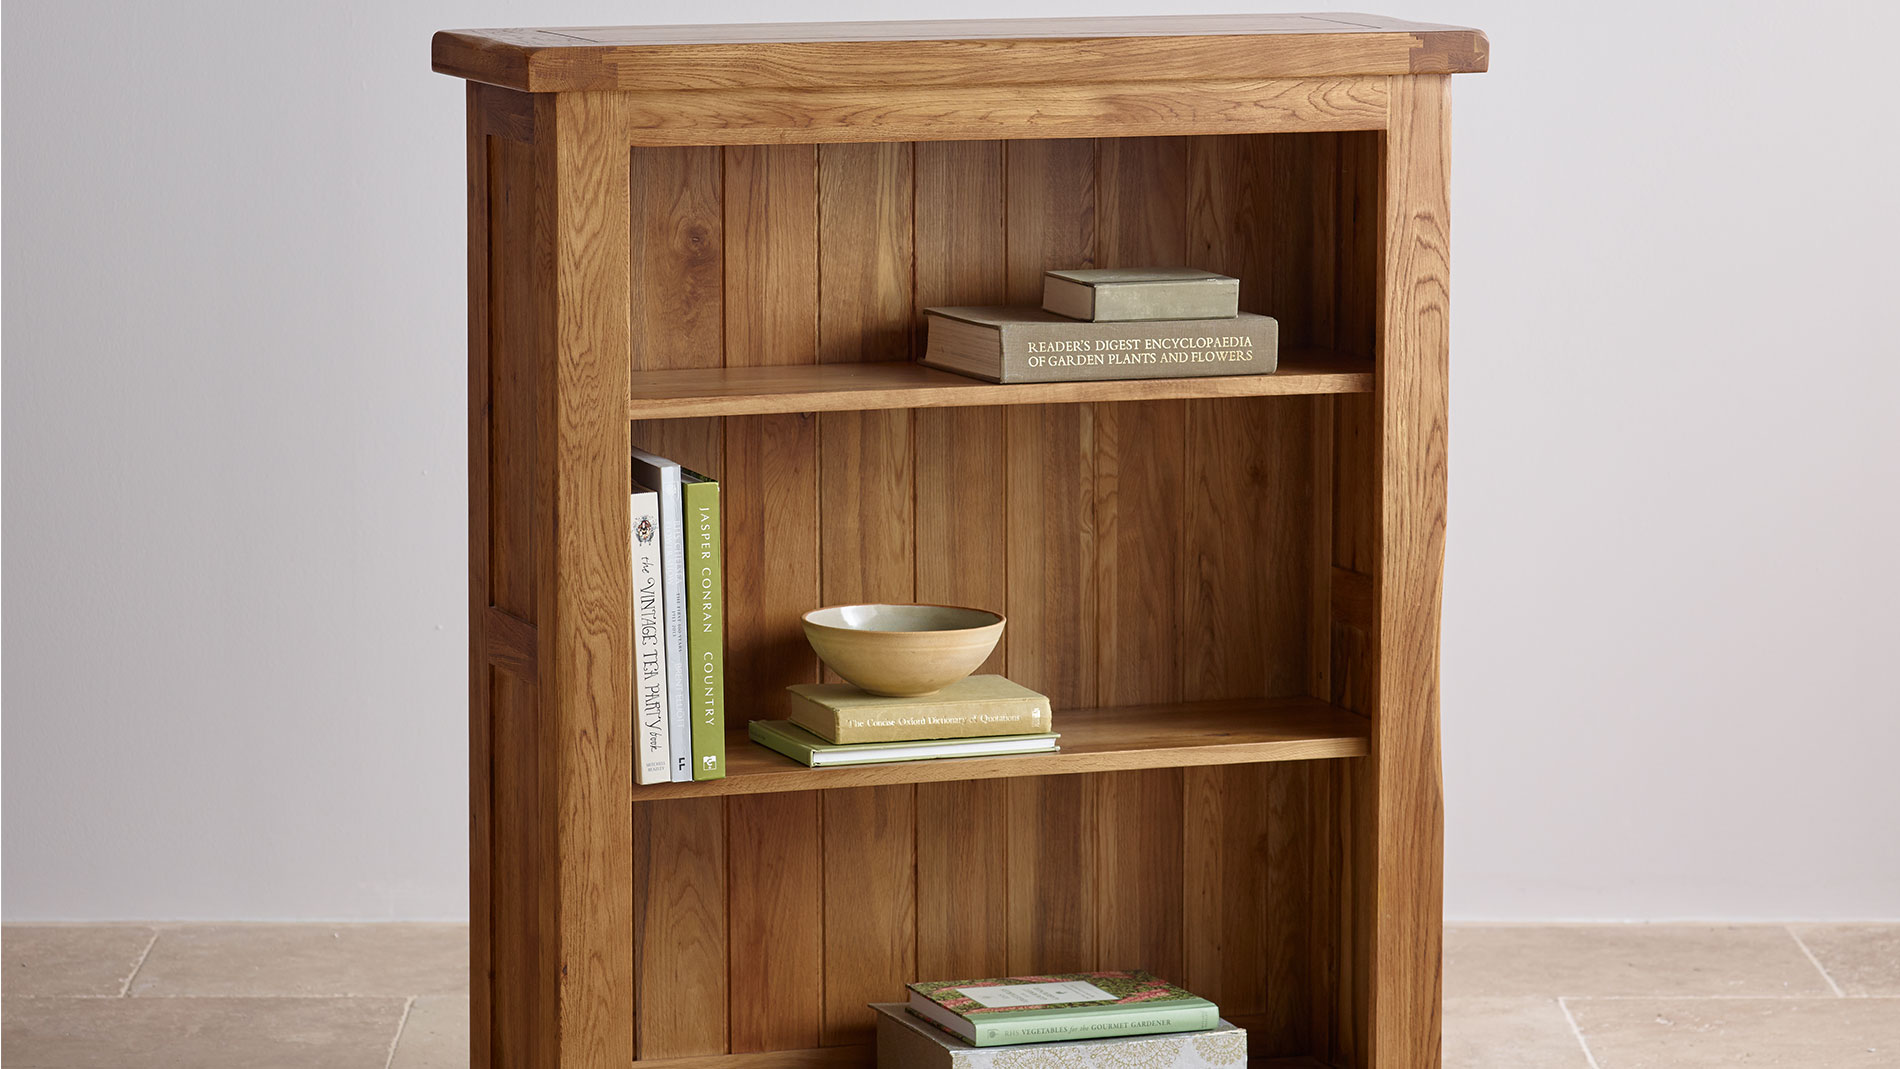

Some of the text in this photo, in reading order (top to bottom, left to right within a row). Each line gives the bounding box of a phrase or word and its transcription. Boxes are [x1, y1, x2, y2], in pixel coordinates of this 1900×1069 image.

[1028, 336, 1253, 353] READER'S DIGEST ENCYCLOPAEDIA
[1028, 350, 1253, 368] OF GARDEN PLANTS AND FLOWERS
[640, 577, 658, 646] VINTAGE
[699, 507, 715, 726] JASPER CONRAN COUNTRY
[643, 648, 660, 680] TEA
[644, 683, 662, 731] PARTY
[847, 719, 864, 729] The
[866, 718, 896, 728] Concise
[898, 716, 926, 726] Oxford
[927, 714, 967, 727] Dictionary
[1021, 1026, 1068, 1036] VEGETABLES
[1068, 1025, 1079, 1035] for
[1079, 1024, 1089, 1033] the
[1090, 1022, 1129, 1031] GOURMET
[1130, 1019, 1172, 1029] GARDENER
